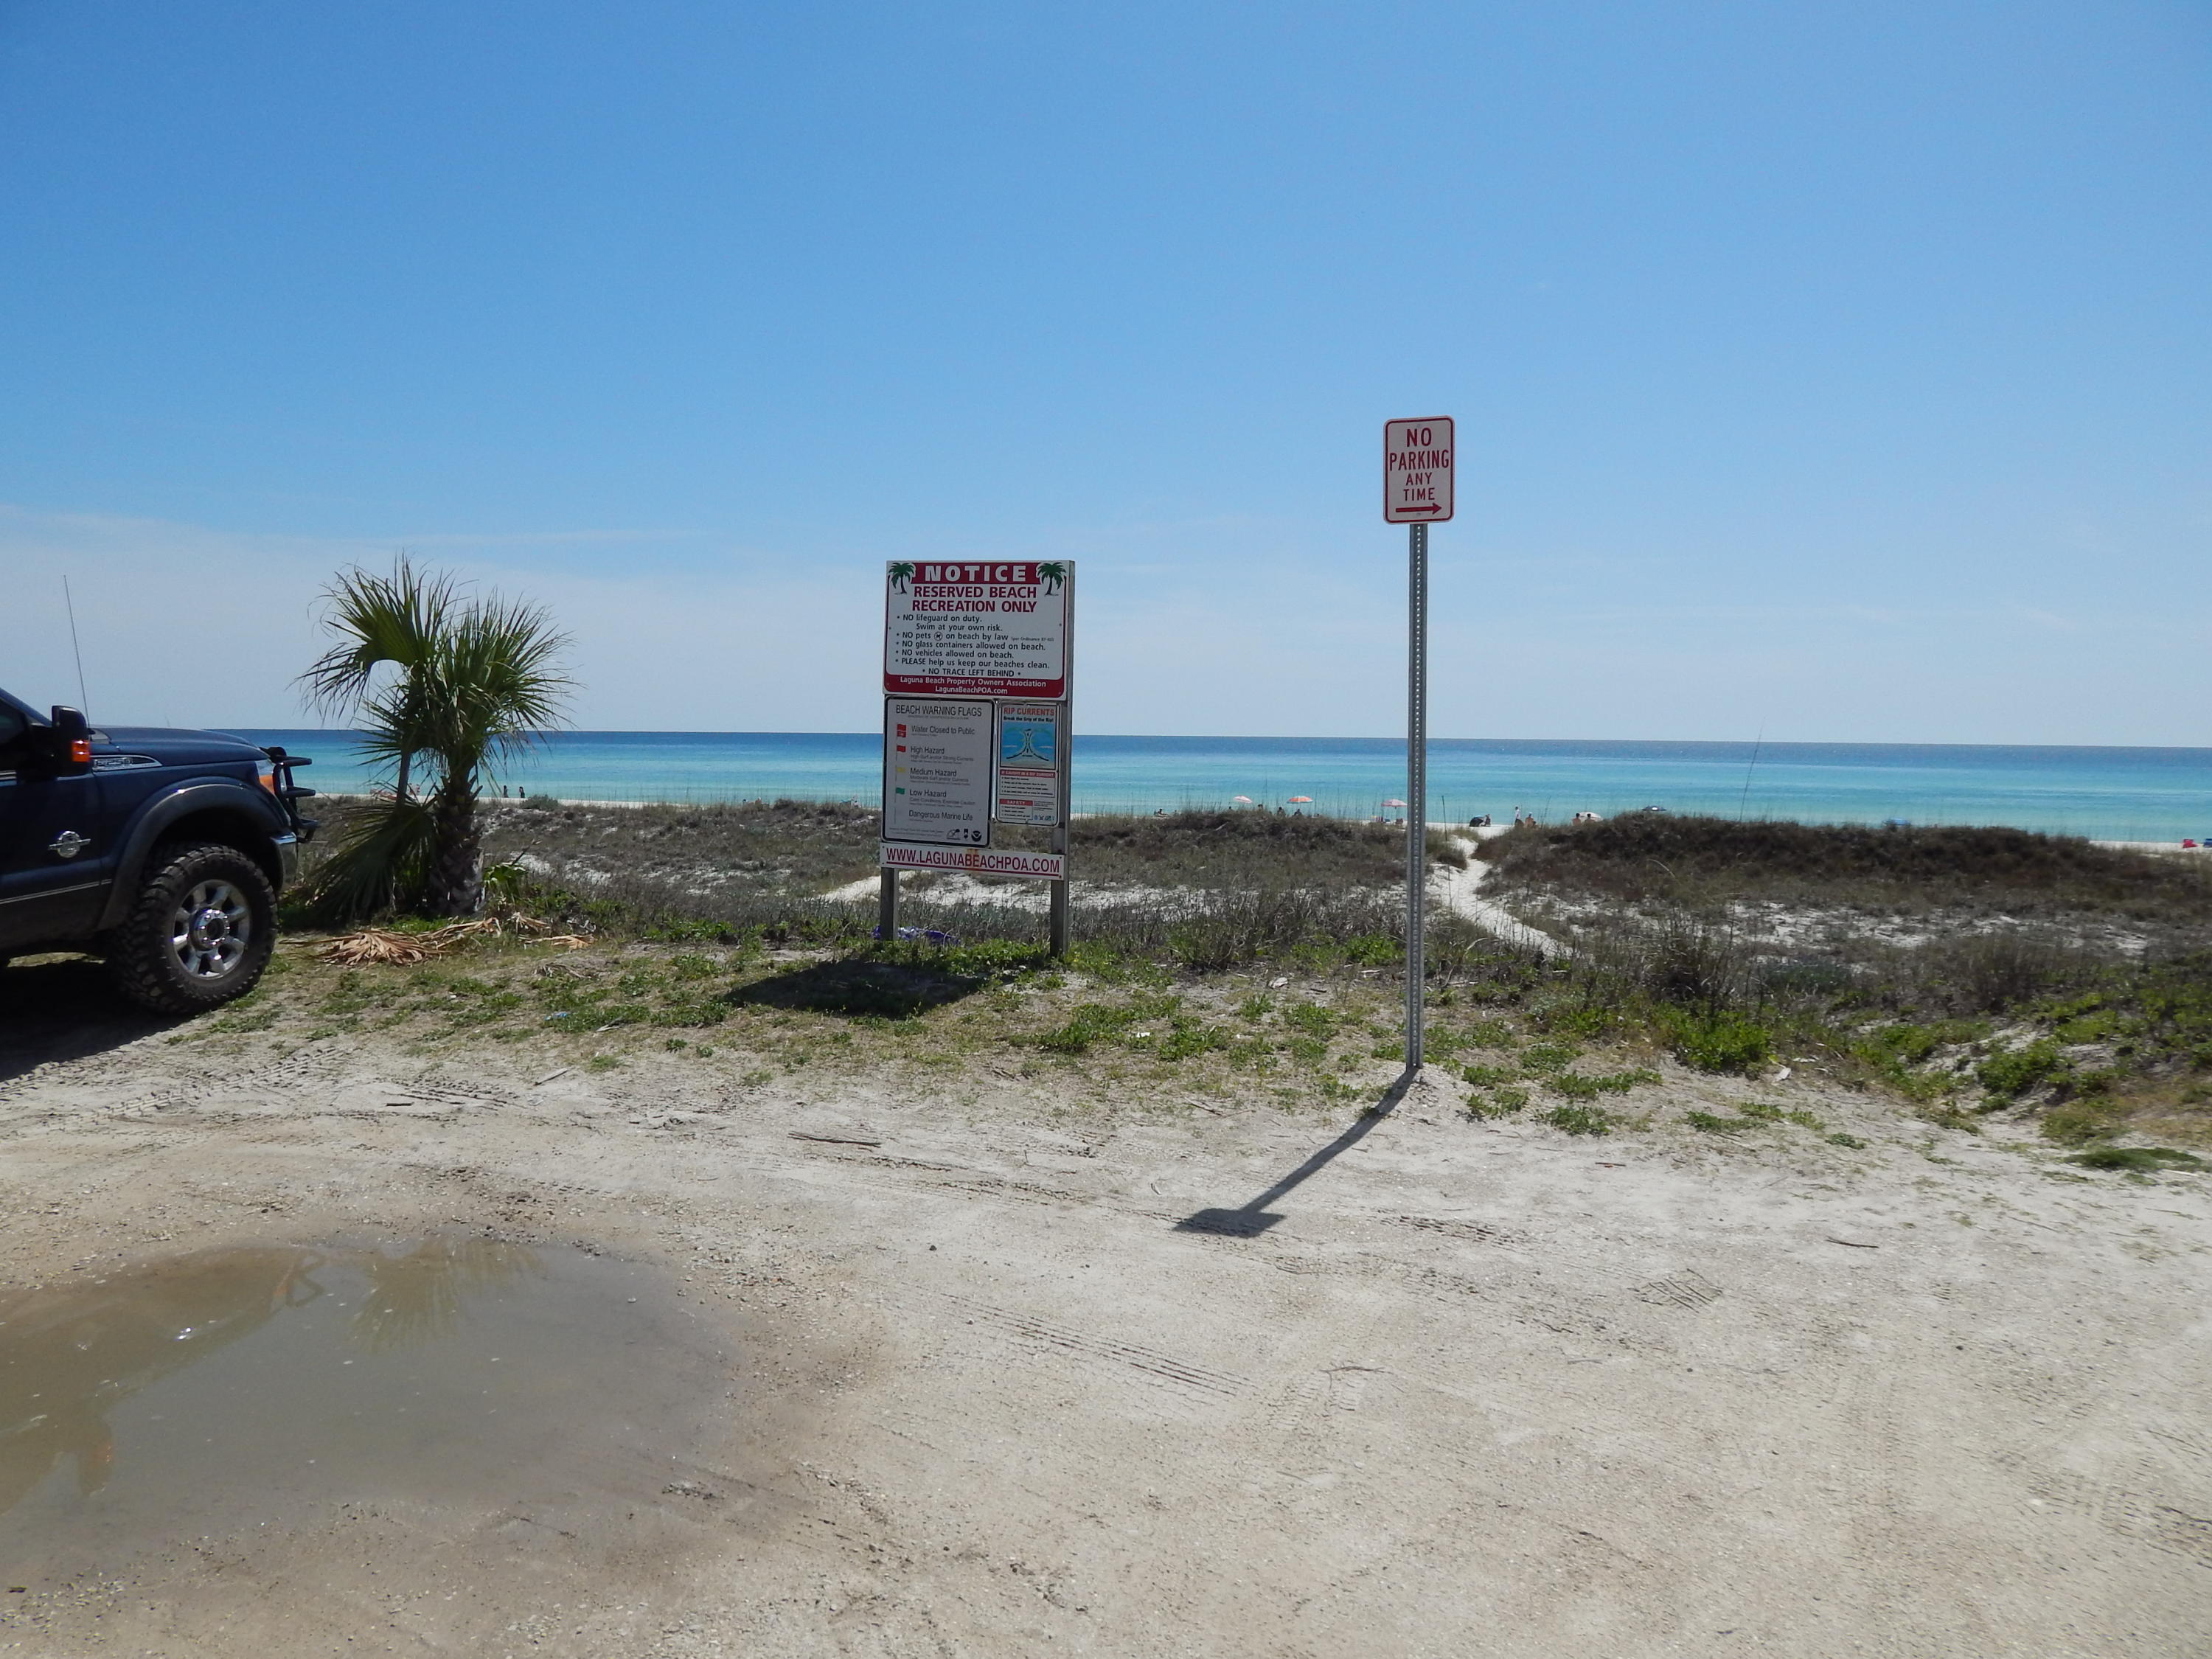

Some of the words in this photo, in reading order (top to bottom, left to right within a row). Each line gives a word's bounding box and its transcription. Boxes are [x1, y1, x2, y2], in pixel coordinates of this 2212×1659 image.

[1406, 428, 1432, 447] NO
[1389, 449, 1450, 471] PARKING
[1405, 472, 1433, 486] ANY
[1403, 487, 1436, 501] TIME
[925, 565, 1026, 582] NOTICE
[914, 585, 984, 598] RESERVED
[989, 586, 1037, 599] BEACH
[911, 599, 995, 612] RECREATION
[1001, 600, 1037, 613] ONLY
[916, 613, 948, 623] lifeguard
[962, 614, 982, 624] duty.
[916, 622, 936, 630] Swim
[915, 632, 931, 640] pets
[958, 632, 980, 640] beach
[982, 633, 992, 642] by
[995, 633, 1009, 641] law
[915, 640, 933, 649] glass
[936, 641, 973, 649] containers
[975, 641, 1006, 650] allowed
[1020, 642, 1046, 650] beach.
[915, 649, 942, 657] vehicles
[945, 650, 975, 658] allowed
[990, 650, 1014, 658] beach.
[928, 658, 945, 667] help
[958, 658, 975, 667] keep
[994, 660, 1024, 668] beaches
[1027, 661, 1050, 669] clean.
[900, 676, 923, 684] Laguna
[947, 678, 975, 686] Property
[1006, 679, 1046, 687] Association
[935, 685, 1008, 695] LagunaBeachPOA.com
[896, 704, 920, 714] BEACH
[922, 706, 956, 715] WARNING
[958, 706, 982, 717] FLAGS
[1016, 708, 1054, 716] CURRENTS
[929, 726, 950, 734] Closed
[959, 727, 975, 735] Public
[911, 745, 923, 754] High
[925, 746, 945, 754] Hazard
[910, 768, 933, 776] Medium
[908, 810, 940, 819] Dangerous
[941, 812, 961, 820] Marine
[886, 848, 1060, 873] WWW.LAGUNABEACHPOA.COM
